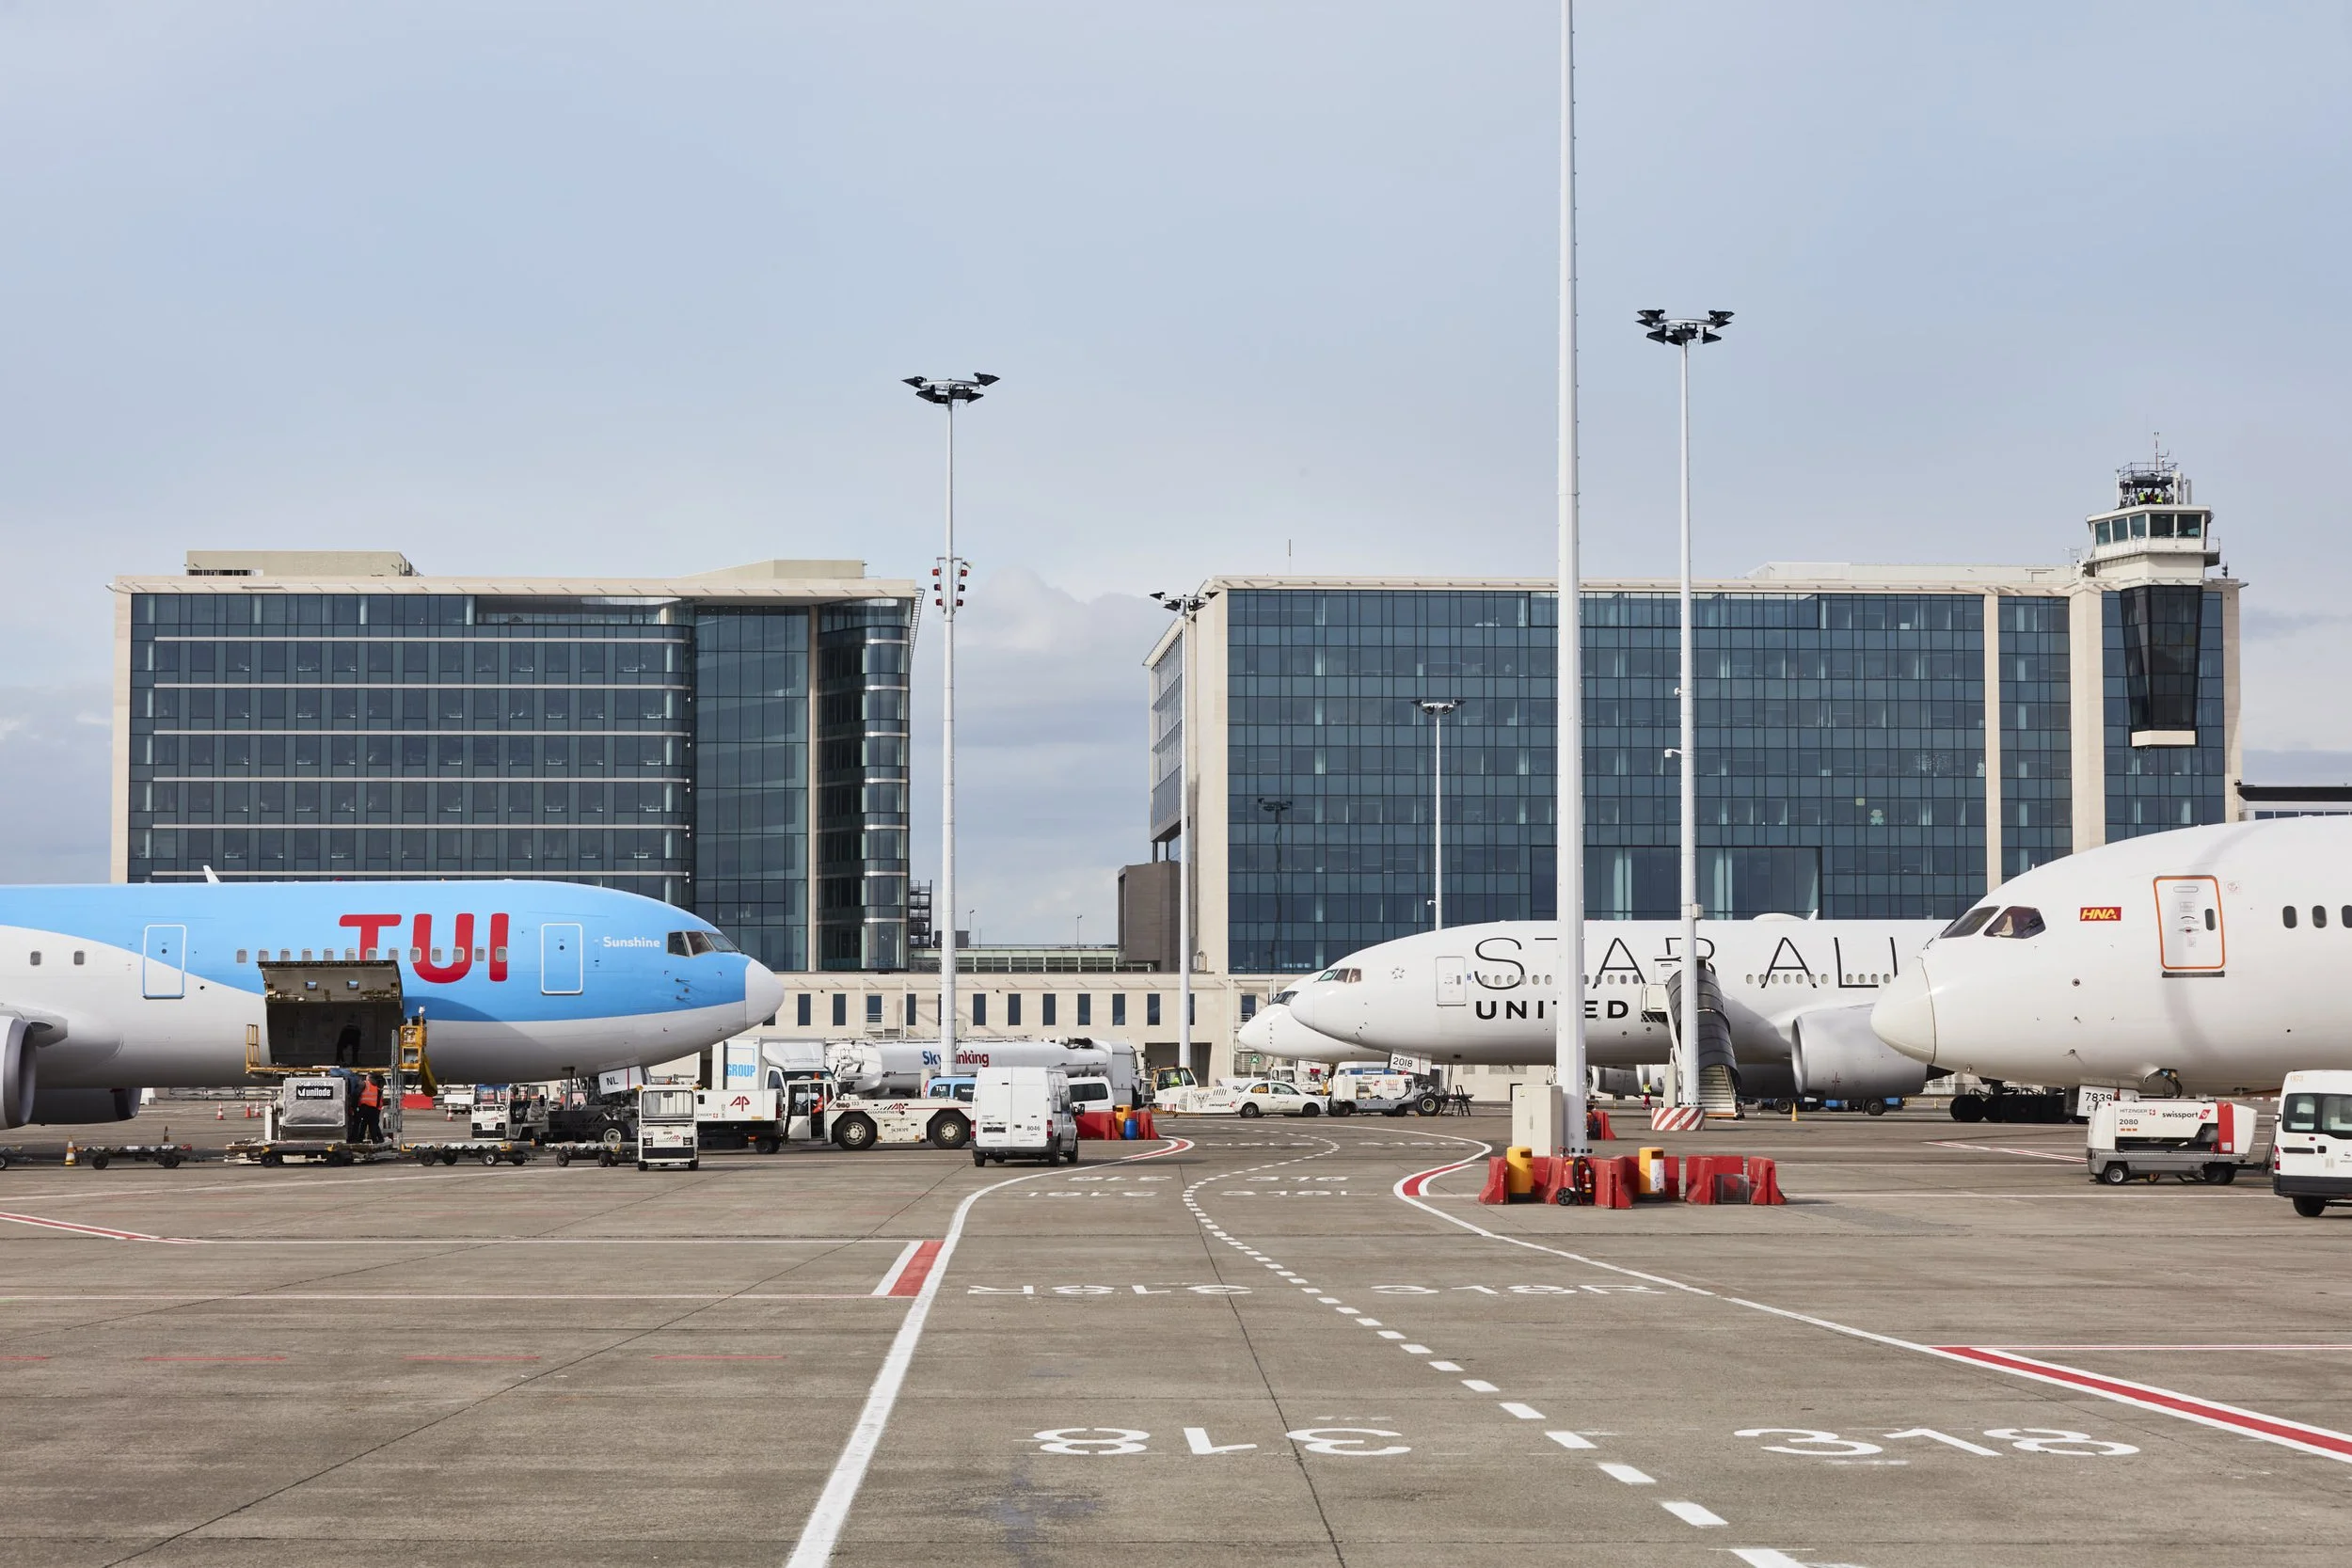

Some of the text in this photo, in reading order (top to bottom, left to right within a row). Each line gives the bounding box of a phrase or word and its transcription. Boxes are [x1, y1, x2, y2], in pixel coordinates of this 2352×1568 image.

[2081, 909, 2118, 920] HNA
[603, 937, 660, 948] Sunshine
[340, 913, 509, 984] TUI
[1475, 1000, 1629, 1020] UNIED
[1392, 1056, 1413, 1068] 2018
[726, 1064, 755, 1077] GROUP
[606, 1077, 619, 1086] NL
[305, 1088, 331, 1097] unilode
[2085, 1092, 2112, 1102] 7839
[2162, 1108, 2199, 1119] swissport
[1033, 1427, 1412, 1456] 318
[1733, 1427, 2141, 1456] 318
